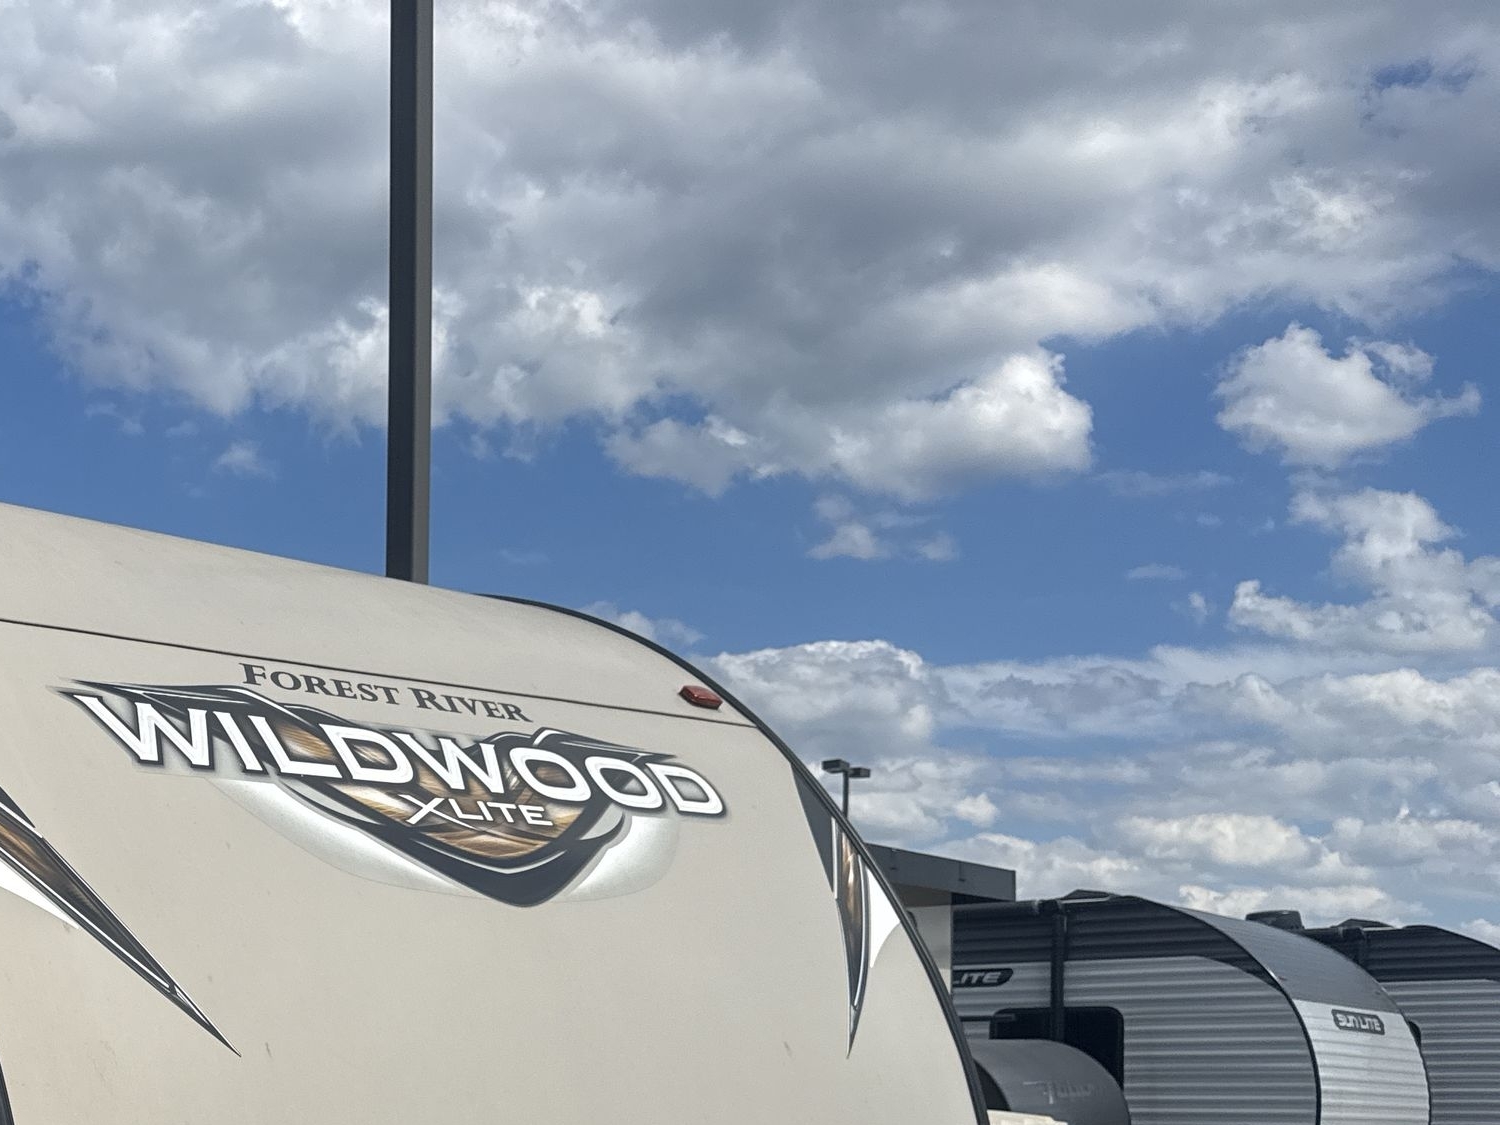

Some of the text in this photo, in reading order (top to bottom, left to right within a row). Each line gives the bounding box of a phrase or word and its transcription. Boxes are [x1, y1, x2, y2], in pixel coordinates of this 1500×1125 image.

[238, 662, 534, 723] FOREST RIVER
[71, 692, 726, 817] WILDWOOD
[953, 971, 1002, 985] ITE
